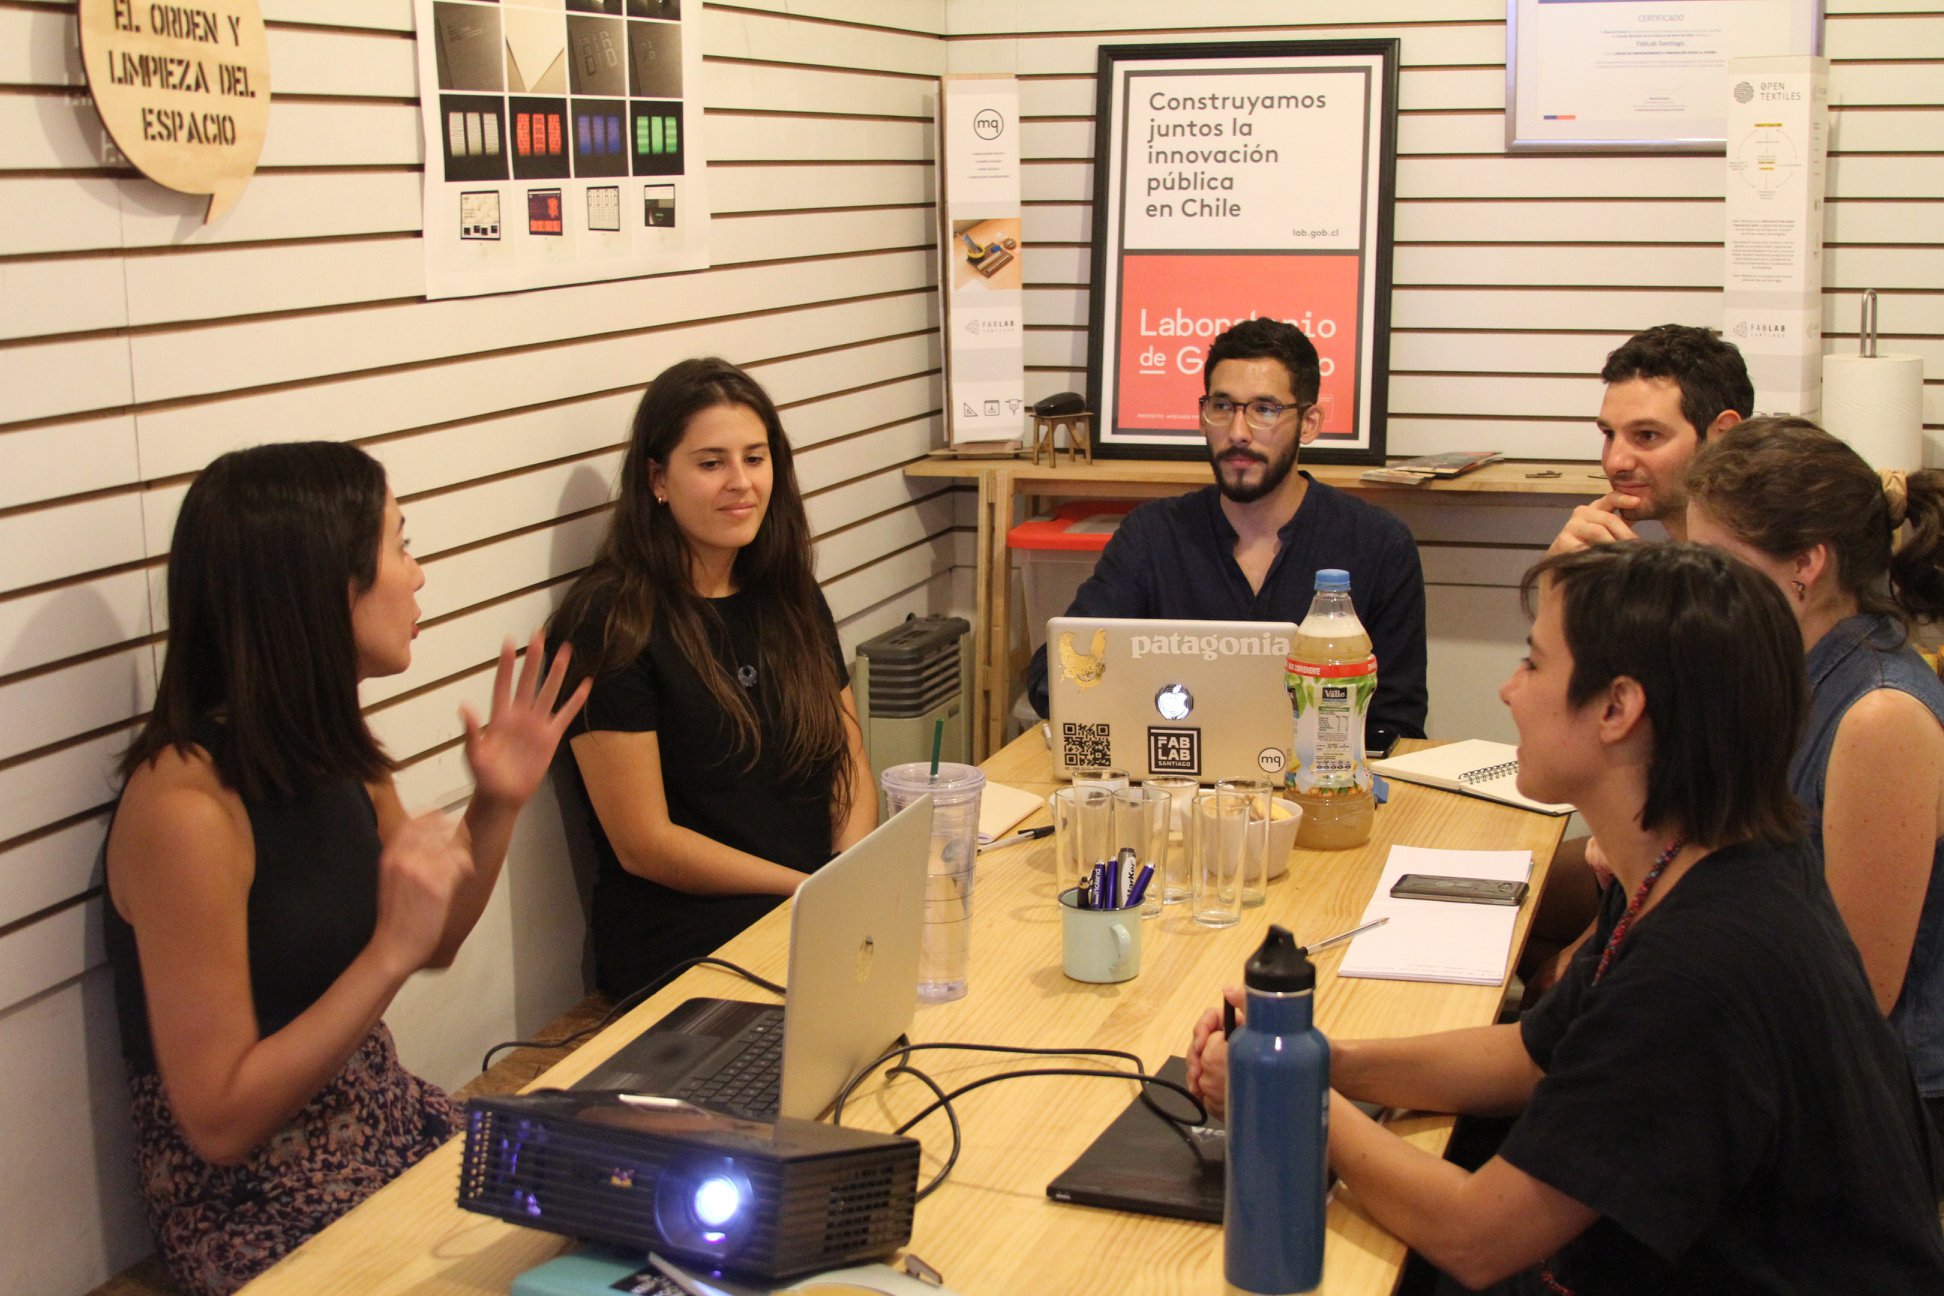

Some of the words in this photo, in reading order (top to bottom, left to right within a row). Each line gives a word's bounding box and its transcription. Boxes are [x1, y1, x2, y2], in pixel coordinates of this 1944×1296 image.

[114, 0, 141, 33] EL
[150, 3, 219, 45] ORDEN
[227, 14, 240, 47] Y
[1637, 14, 1685, 22] CERTIFICADO
[109, 50, 210, 94] LIMPIEZA
[218, 63, 256, 98] DEL
[1149, 92, 1327, 116] Construyamos
[1760, 91, 1801, 101] TEXTILES
[142, 107, 236, 146] ESPACIO
[977, 119, 999, 134] mq
[1147, 117, 1224, 144] juntos
[1232, 117, 1253, 137] la
[1148, 144, 1279, 165] innovación
[1146, 170, 1234, 197] pública
[1145, 203, 1173, 218] en
[1181, 198, 1242, 218] Chile
[1292, 228, 1340, 239] lab.gob.cl
[1139, 346, 1166, 367] de
[1131, 632, 1290, 661] patagonia
[1157, 736, 1191, 749] FAB
[1158, 748, 1191, 761] LAB
[1261, 755, 1281, 768] mq
